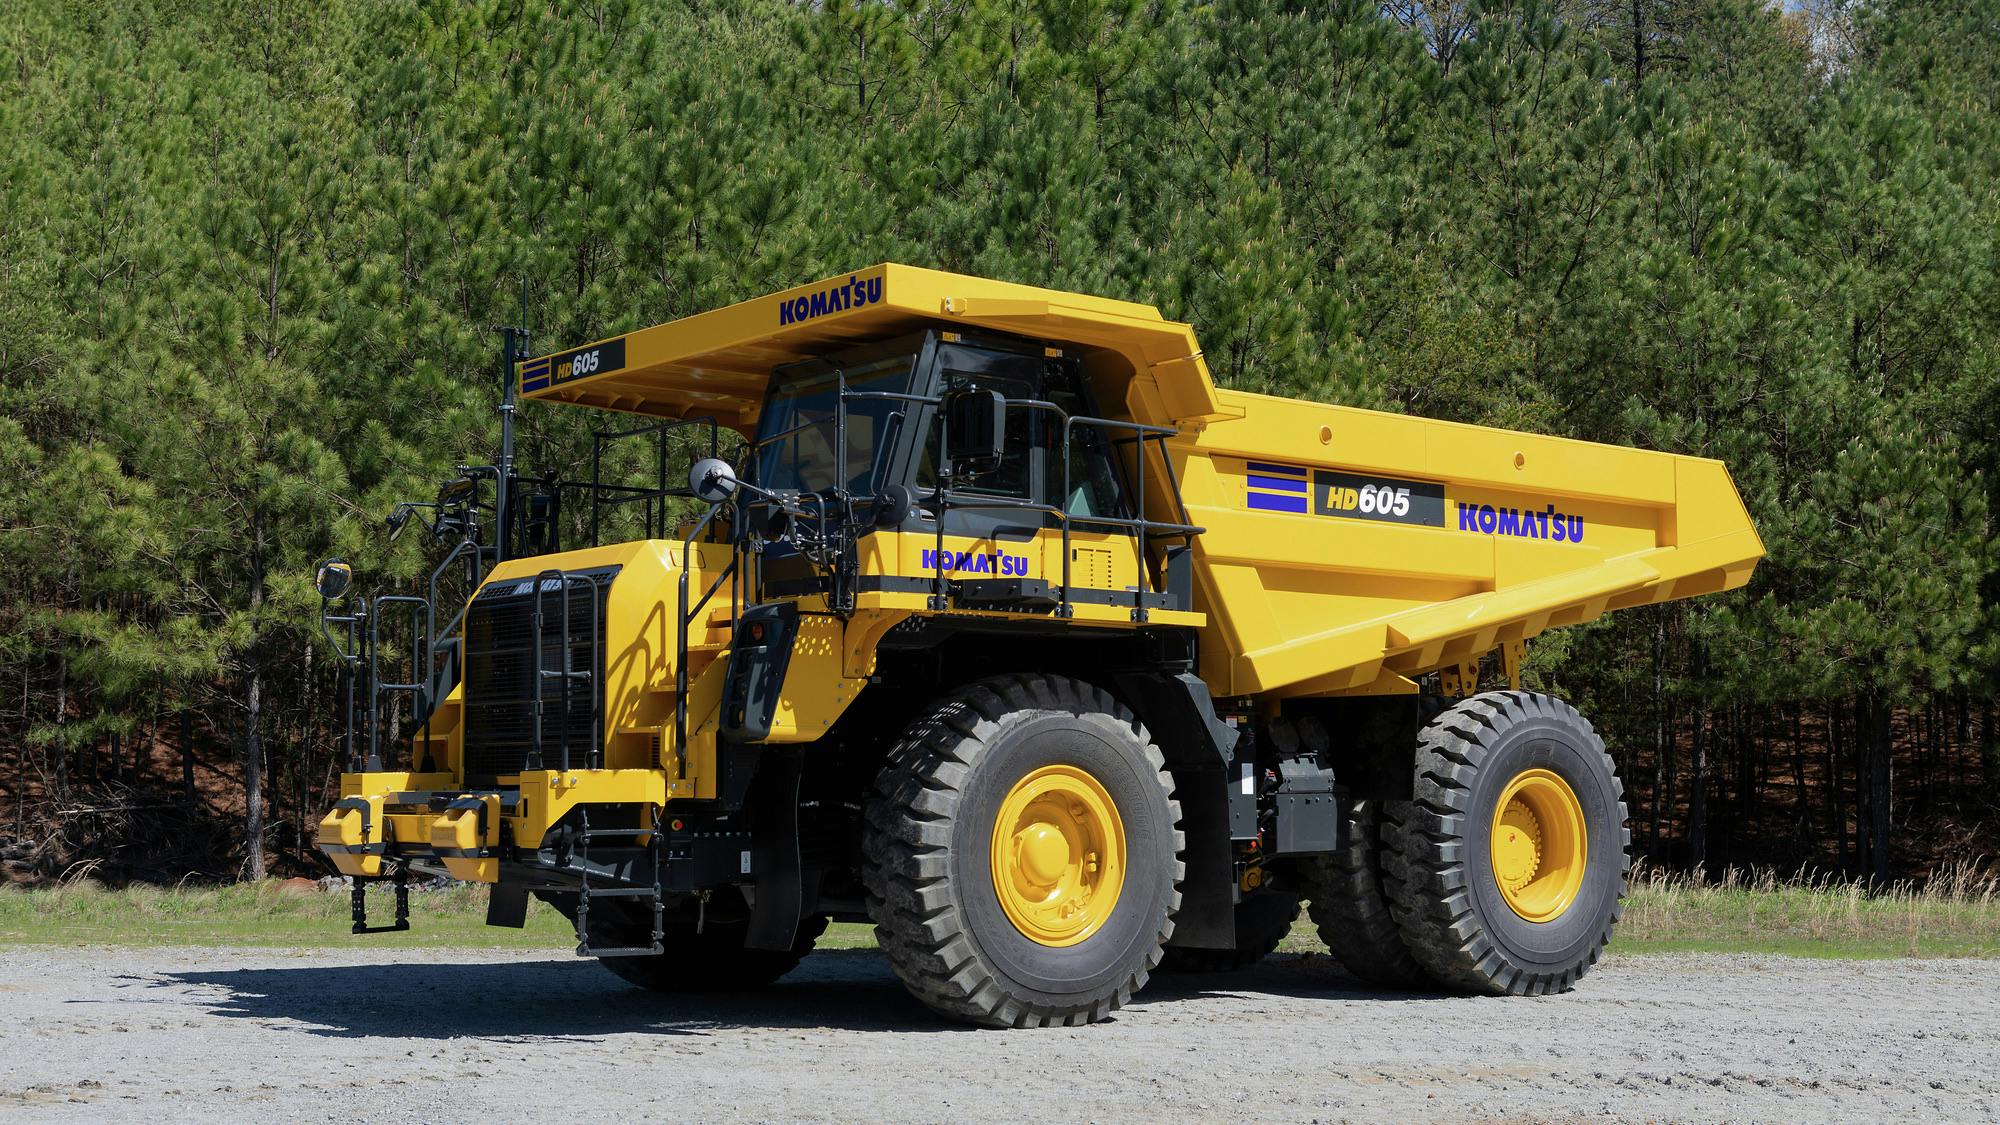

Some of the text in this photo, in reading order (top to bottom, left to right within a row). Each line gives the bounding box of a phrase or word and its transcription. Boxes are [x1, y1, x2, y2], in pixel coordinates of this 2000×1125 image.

[780, 276, 881, 325] KOMATSU
[556, 350, 600, 379] HD605
[1327, 484, 1410, 517] HD605
[1458, 503, 1584, 543] KOMATSU
[922, 549, 1028, 577] KOMATSU
